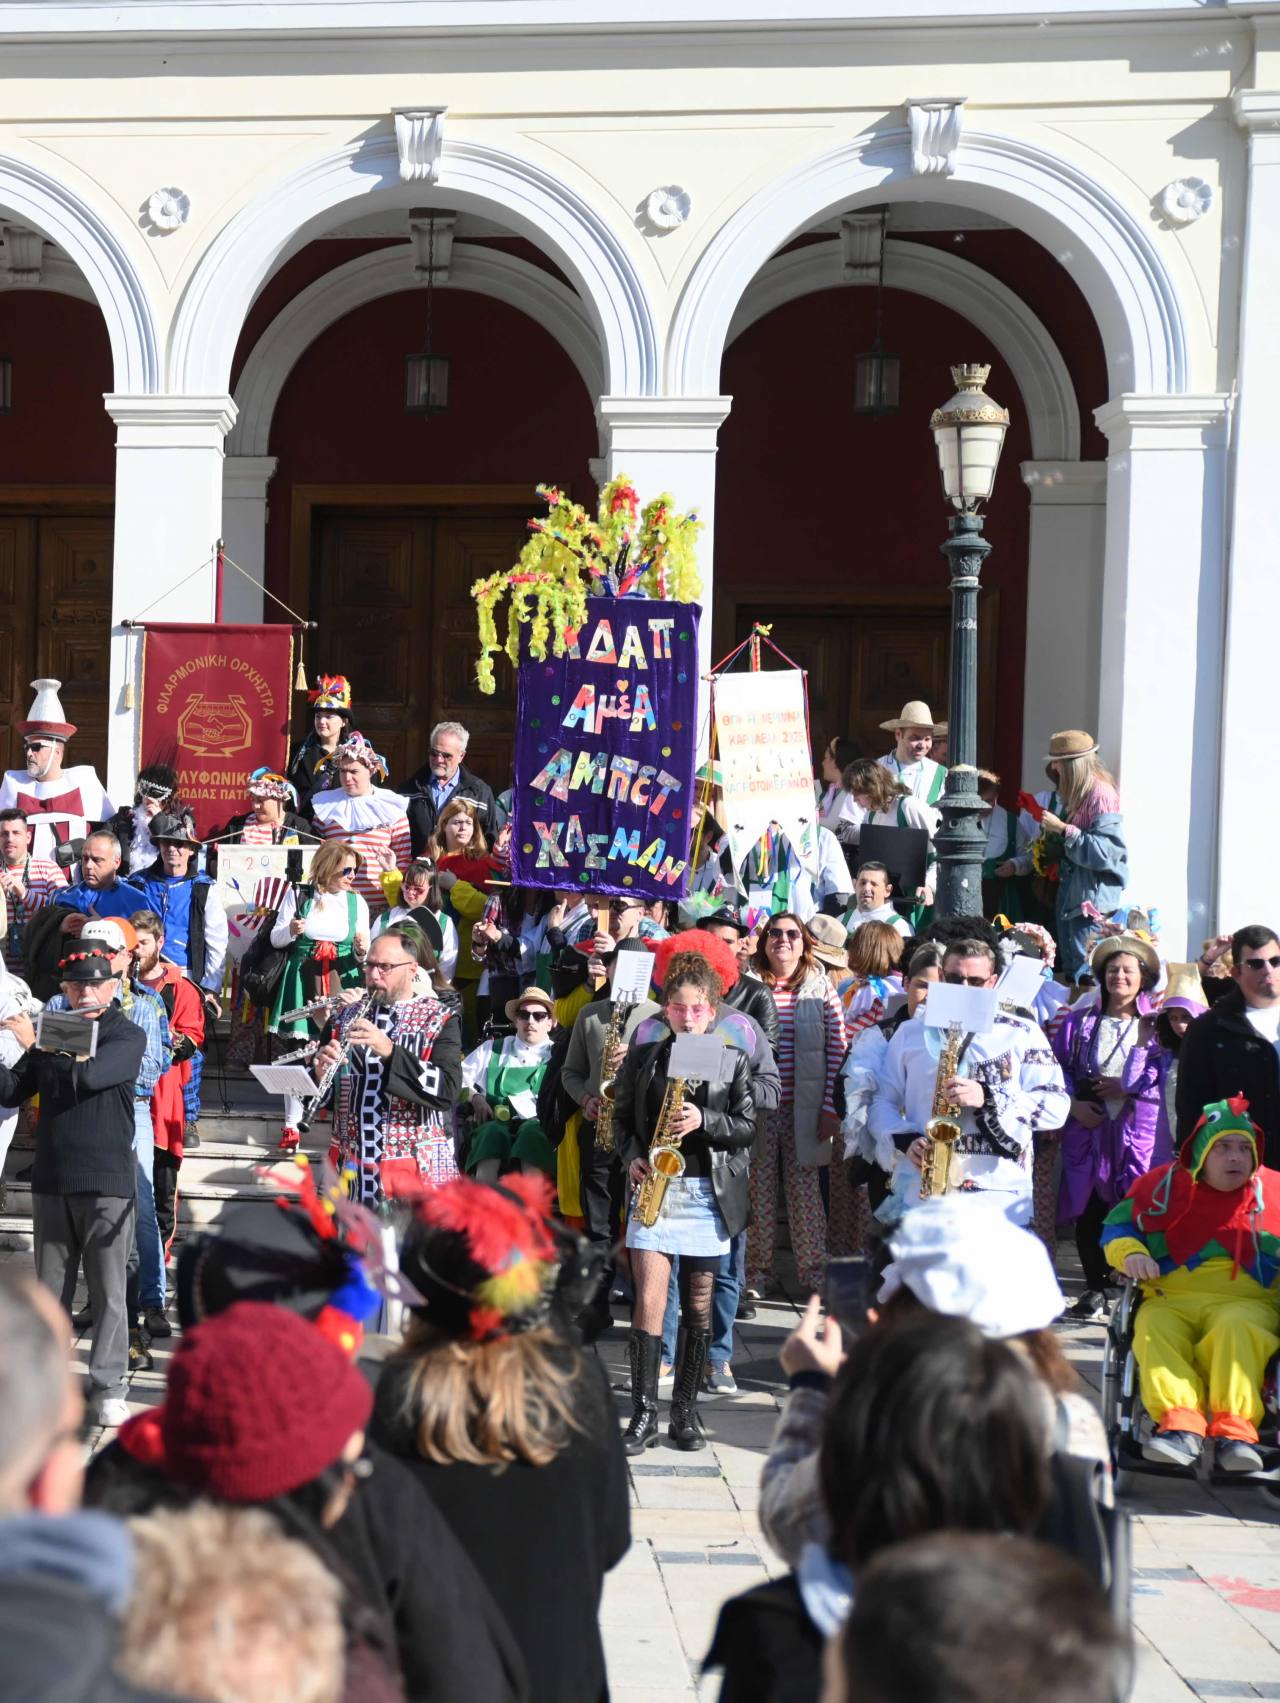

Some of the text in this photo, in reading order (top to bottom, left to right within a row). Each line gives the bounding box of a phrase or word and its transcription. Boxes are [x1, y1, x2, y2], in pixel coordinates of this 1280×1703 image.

[156, 655, 276, 717] ΦΙΛΑΡΜΟΝΙΚΗ ΟΡΧΗΣΤΡΑ
[176, 769, 250, 786] ΛΥΦΩΝΙΚ
[220, 788, 252, 800] ΠΑΤΡ
[532, 814, 687, 886] ΧΑΣΜΑΝ
